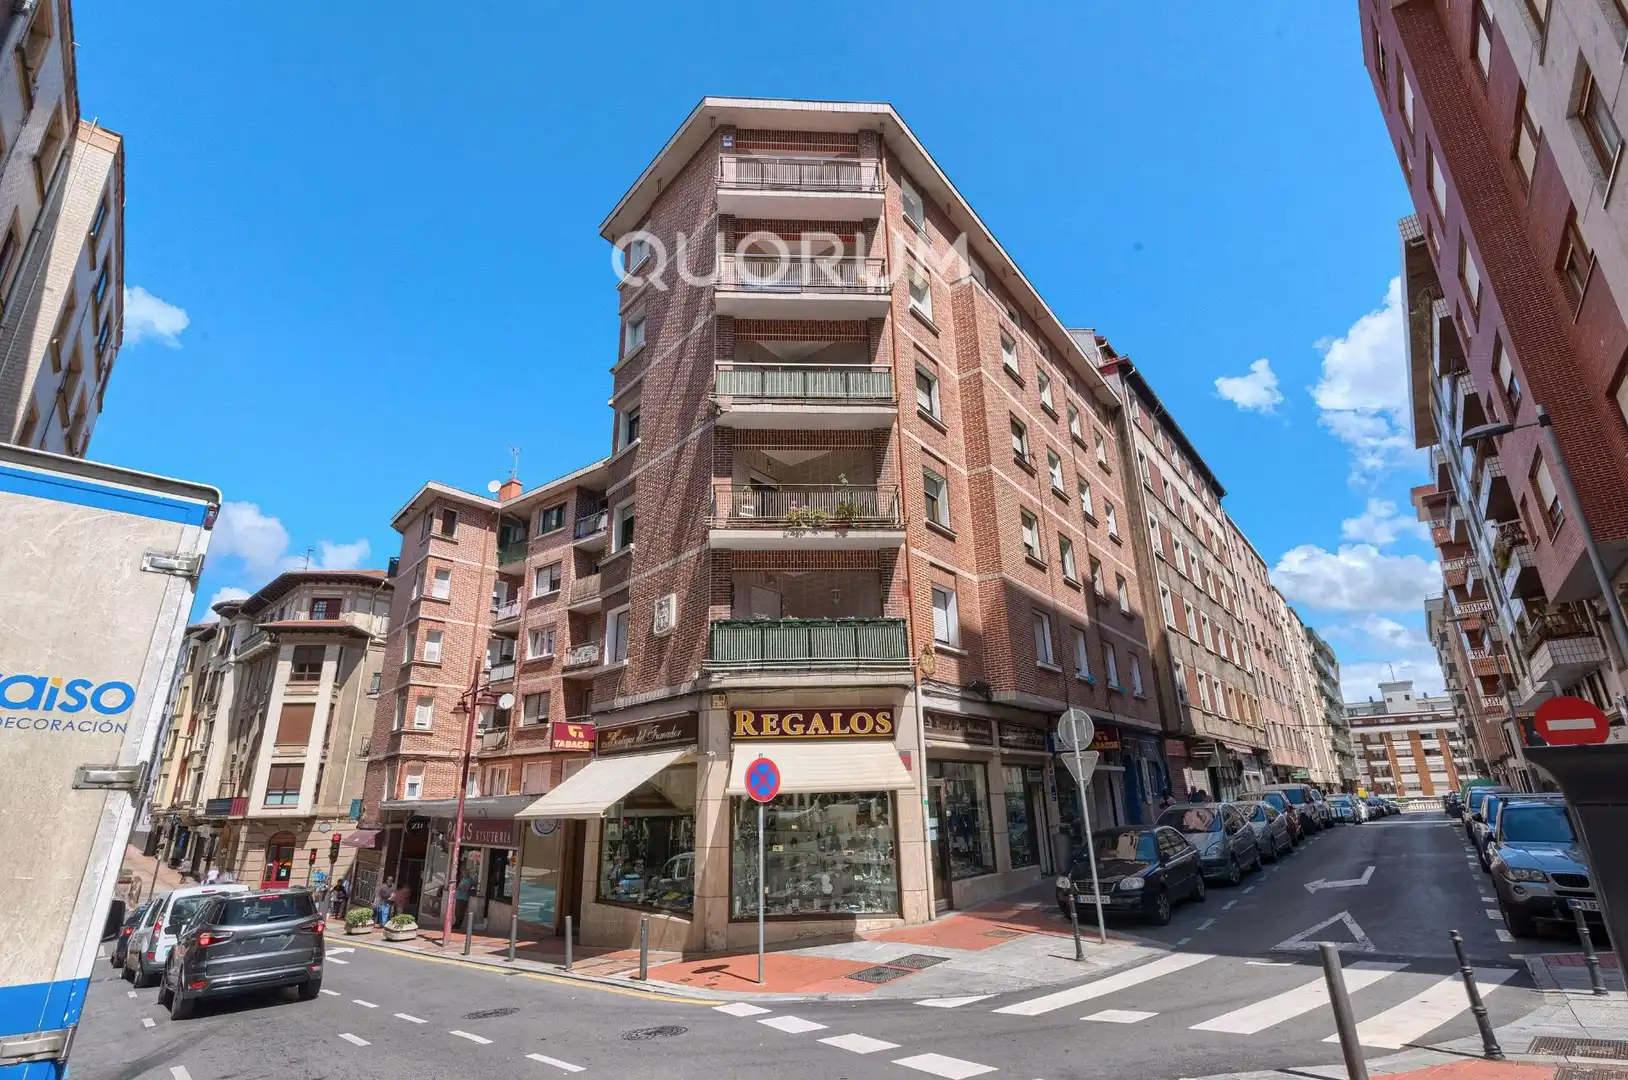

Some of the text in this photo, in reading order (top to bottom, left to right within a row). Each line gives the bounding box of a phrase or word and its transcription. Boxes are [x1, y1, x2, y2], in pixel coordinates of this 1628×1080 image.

[0, 673, 135, 715] aiso
[0, 716, 128, 733] ECORACIÓN
[733, 710, 892, 736] REGALOS
[554, 739, 594, 749] TABACOS
[447, 820, 473, 841] PAIS
